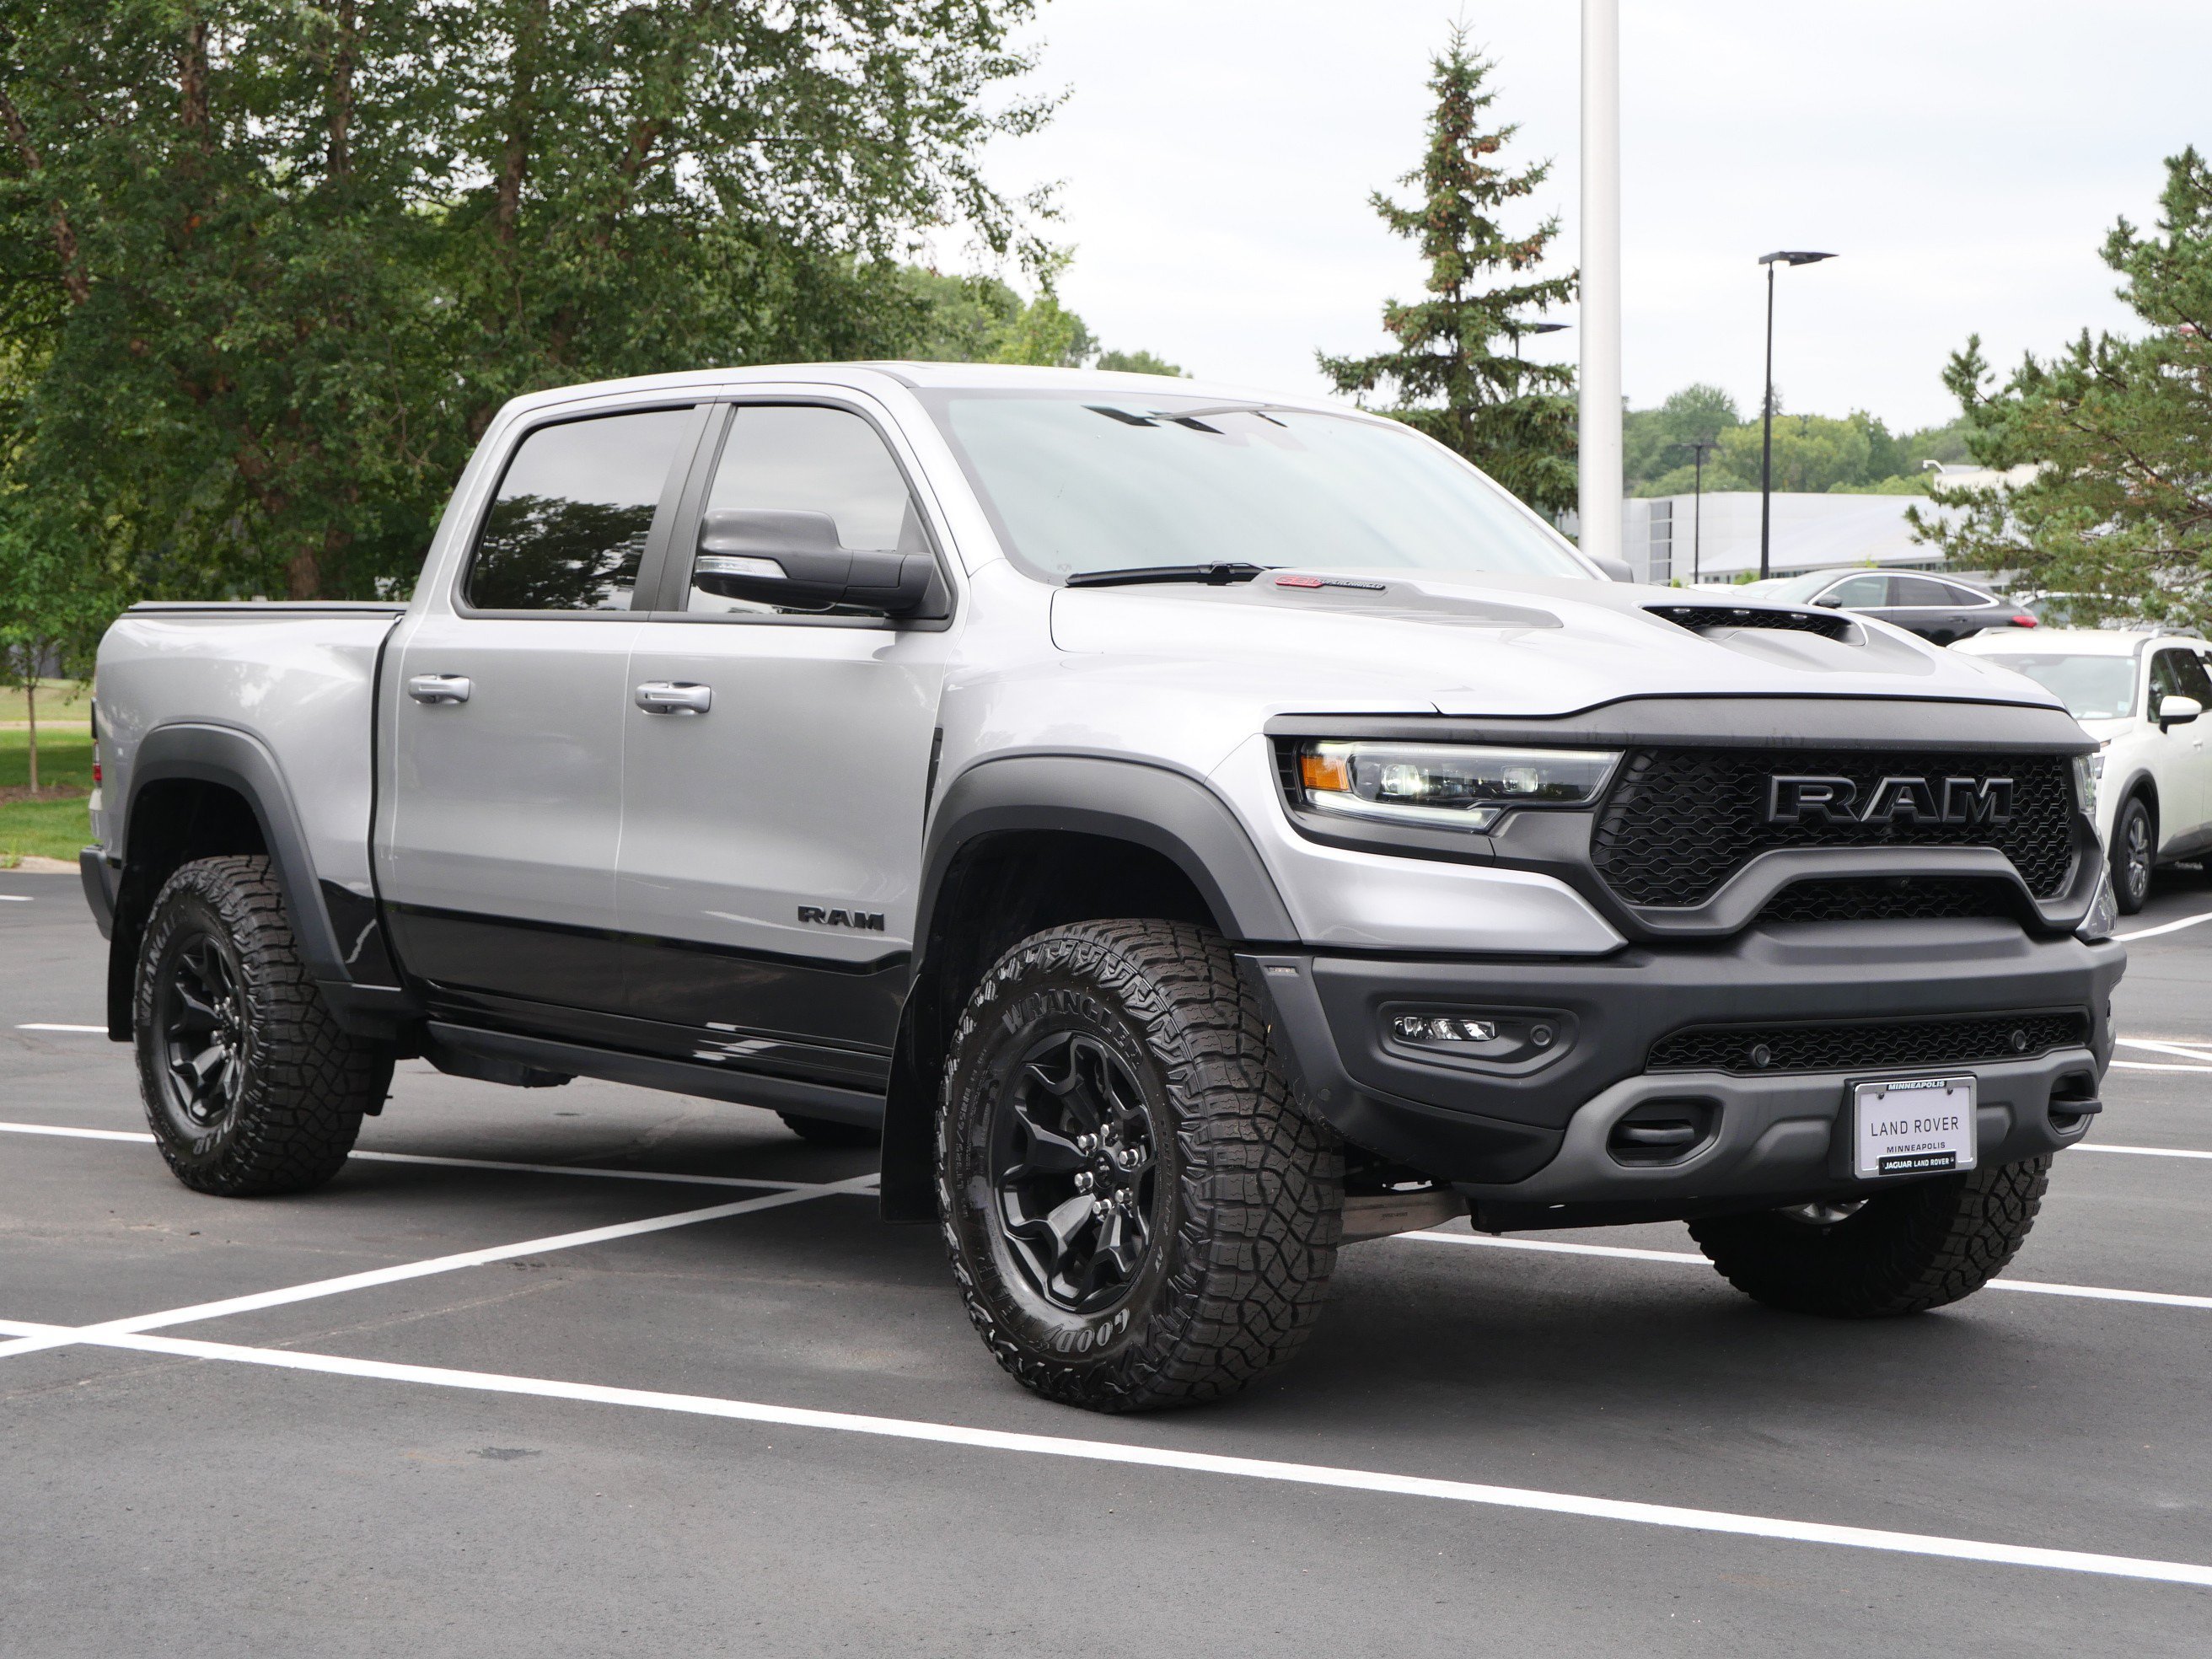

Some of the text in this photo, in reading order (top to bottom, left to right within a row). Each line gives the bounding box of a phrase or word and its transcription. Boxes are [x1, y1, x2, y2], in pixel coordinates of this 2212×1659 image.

[1317, 577, 1383, 588] SUPERCHARGED
[1769, 776, 2014, 823] RAM
[797, 904, 884, 932] RAM
[1001, 989, 1142, 1069] WRANGLER
[1888, 1081, 1945, 1090] MINNEAPOLIS
[1871, 1116, 1958, 1136] LAND ROVER
[1886, 1141, 1946, 1153] MINNEAPOLIS
[1884, 1160, 1913, 1170] JAGUAR
[1914, 1159, 1930, 1168] LAND
